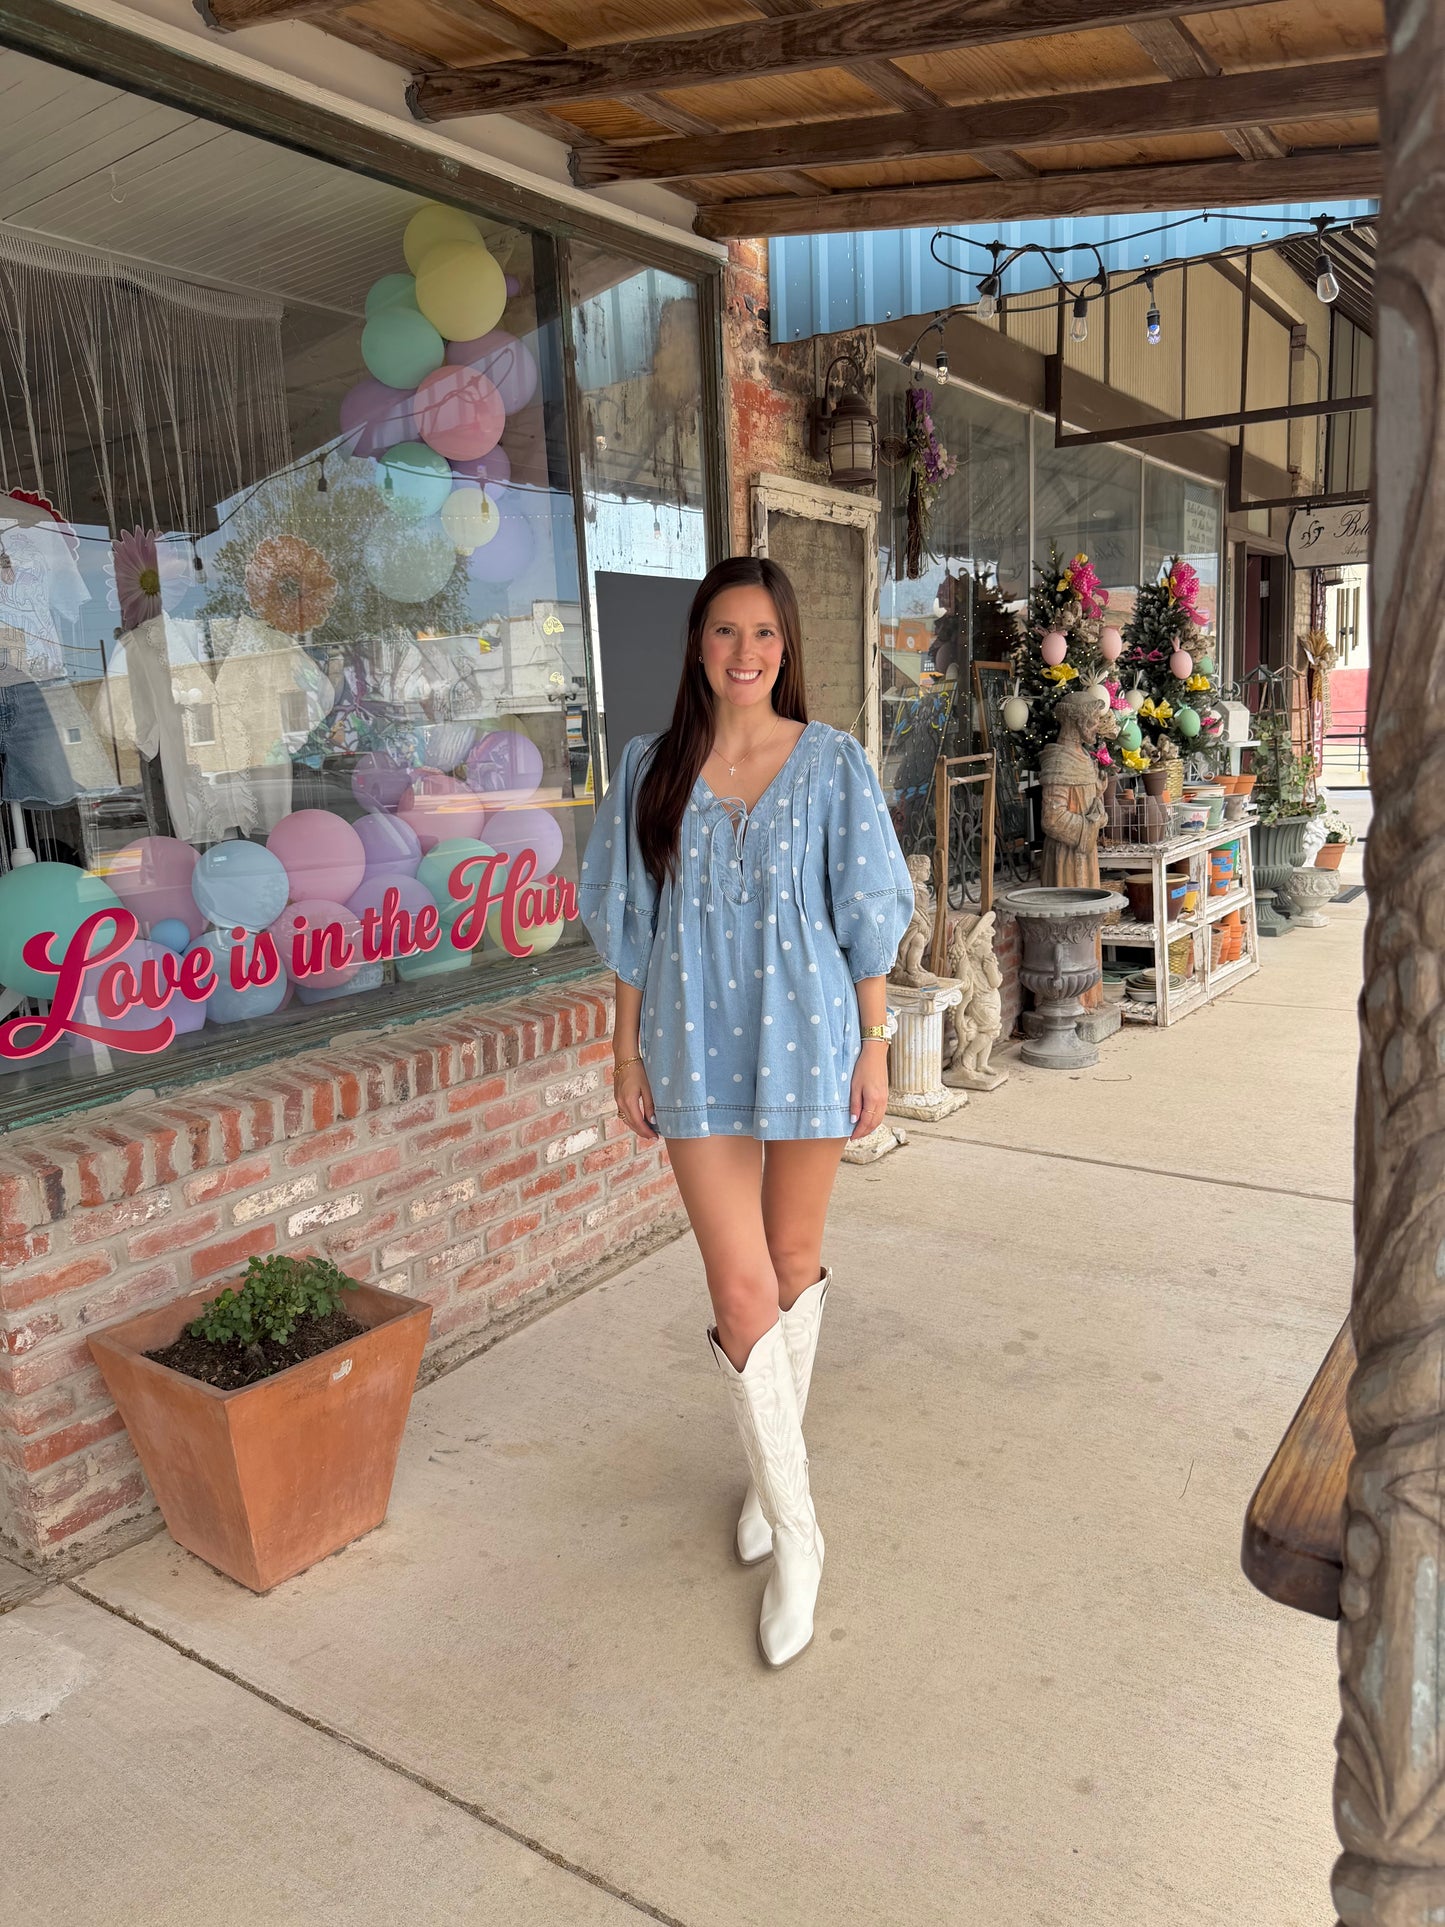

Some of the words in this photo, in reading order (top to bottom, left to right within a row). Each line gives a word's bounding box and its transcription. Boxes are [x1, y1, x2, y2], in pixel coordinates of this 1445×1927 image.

[1333, 509, 1371, 538] Bell
[0, 907, 219, 1059] Love
[230, 926, 281, 992] is
[292, 915, 353, 977] in
[361, 886, 441, 964] the
[448, 848, 580, 958] Hair
